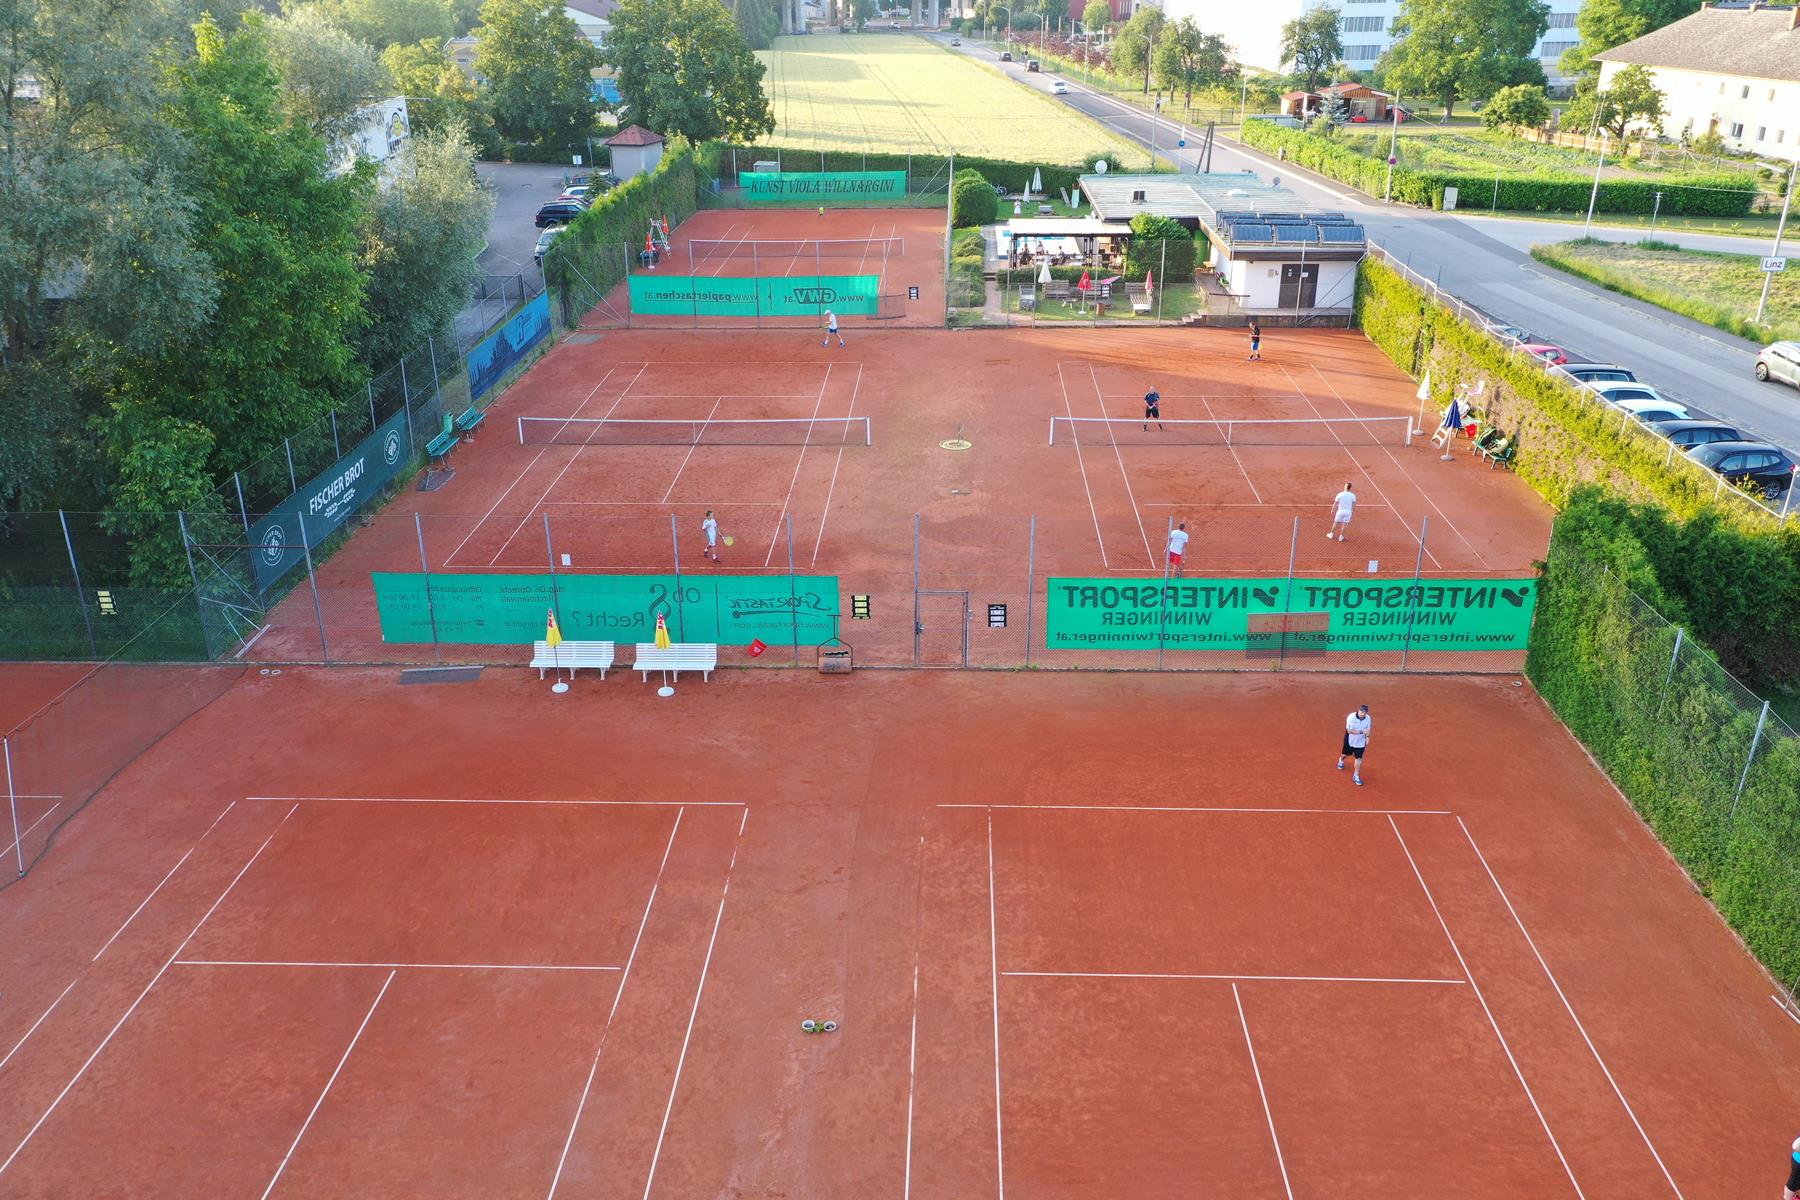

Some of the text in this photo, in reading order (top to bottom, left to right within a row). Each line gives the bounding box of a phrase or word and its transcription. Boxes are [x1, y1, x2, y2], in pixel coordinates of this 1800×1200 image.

[751, 180, 786, 193] KUNST
[788, 179, 820, 193] VIOLA
[1764, 260, 1783, 269] Linz
[309, 476, 345, 516] FISCHER
[345, 457, 365, 488] BROT
